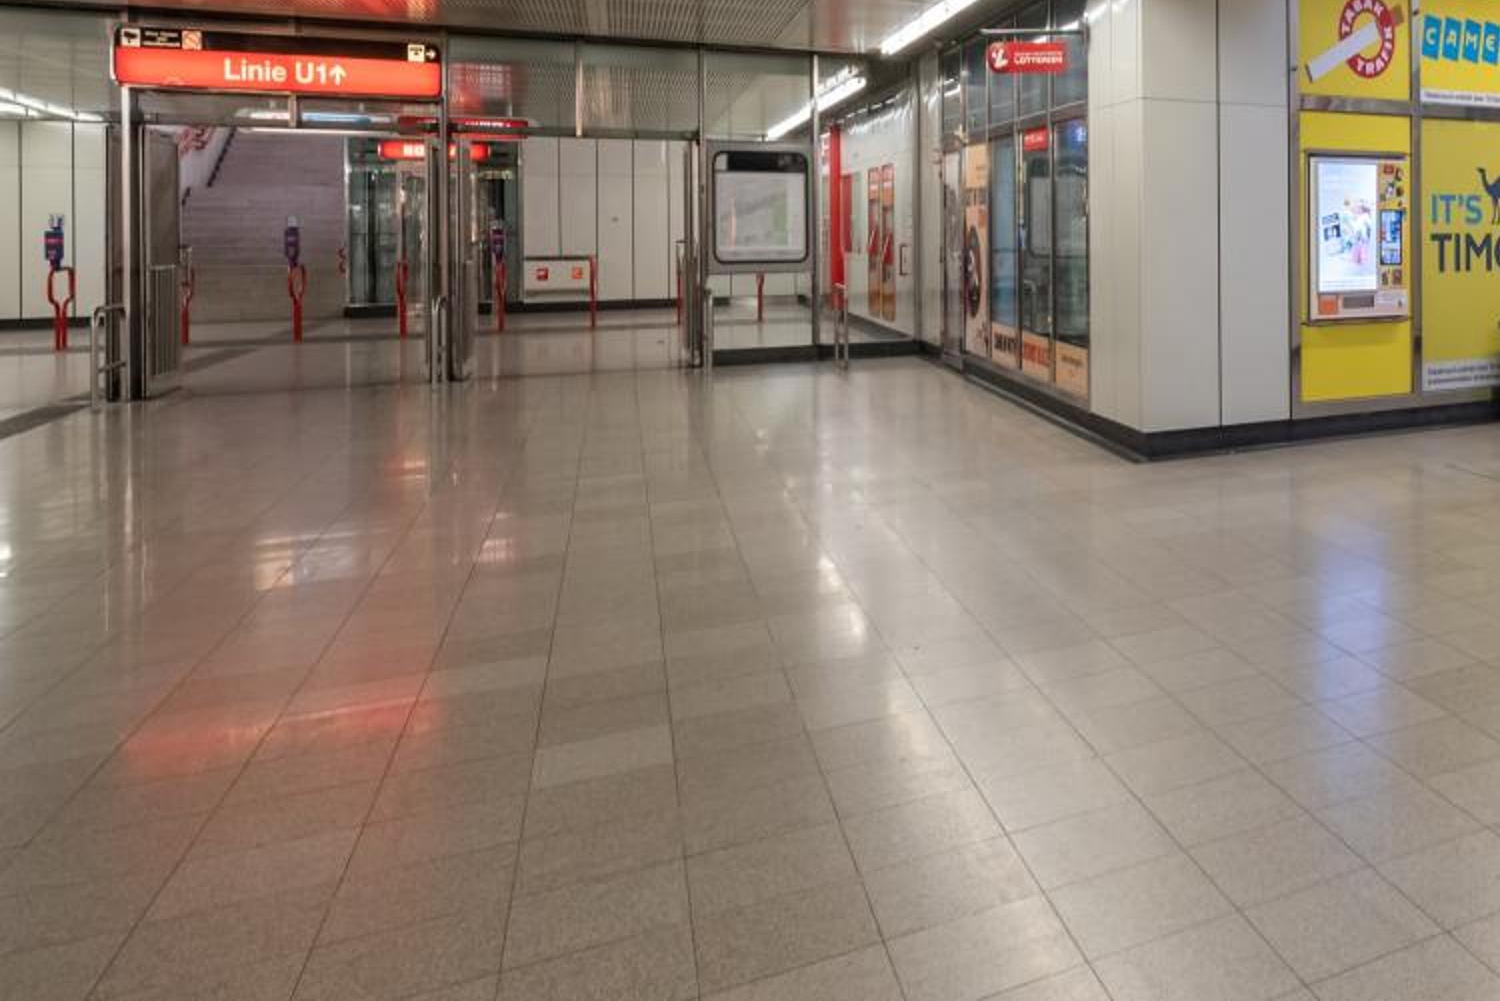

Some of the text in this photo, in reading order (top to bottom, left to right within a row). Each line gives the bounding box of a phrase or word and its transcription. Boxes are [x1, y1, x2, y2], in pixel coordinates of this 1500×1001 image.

[223, 57, 327, 85] Linie U1
[1431, 194, 1483, 225] IT'S
